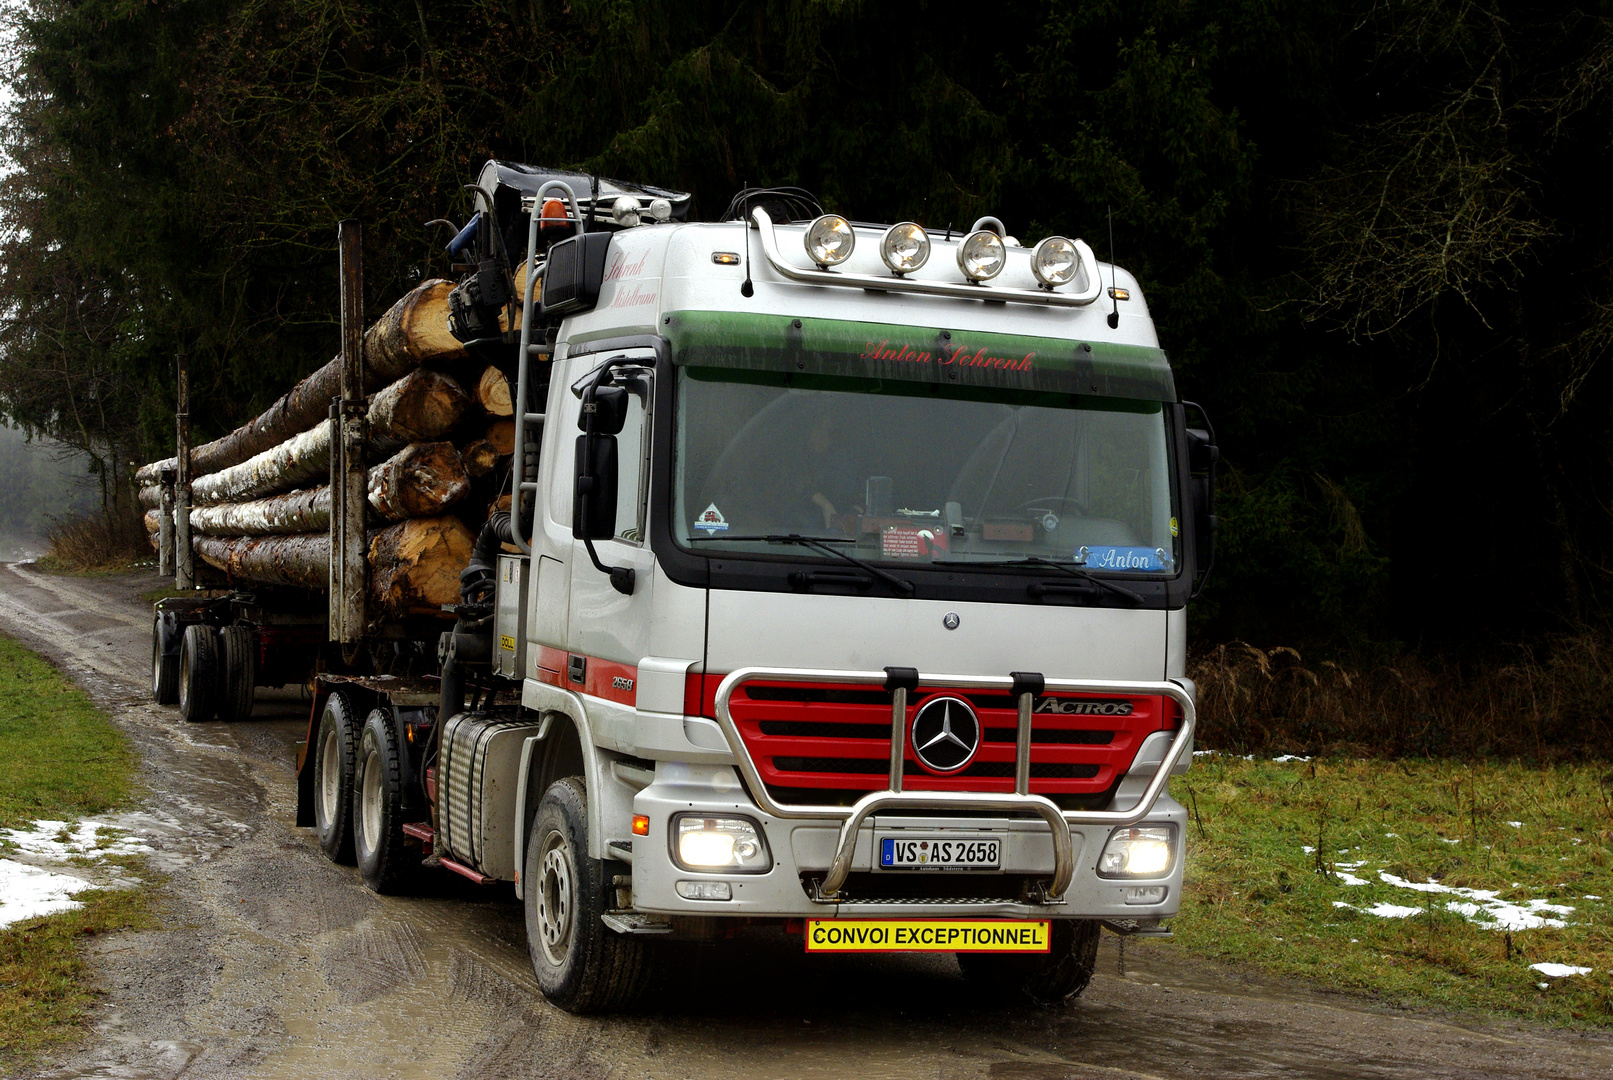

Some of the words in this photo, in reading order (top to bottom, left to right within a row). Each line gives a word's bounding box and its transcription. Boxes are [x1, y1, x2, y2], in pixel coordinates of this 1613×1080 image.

[604, 248, 652, 281] Schrenk
[860, 339, 932, 363] Anton
[938, 343, 1036, 372] Schrenk
[1098, 549, 1150, 569] Anton
[612, 676, 634, 691] 2658
[895, 842, 918, 863] VS
[930, 842, 953, 863] AS
[955, 842, 998, 863] 2658
[813, 927, 889, 944] CONVOI
[894, 928, 1043, 945] EXCEPTIONNEL
